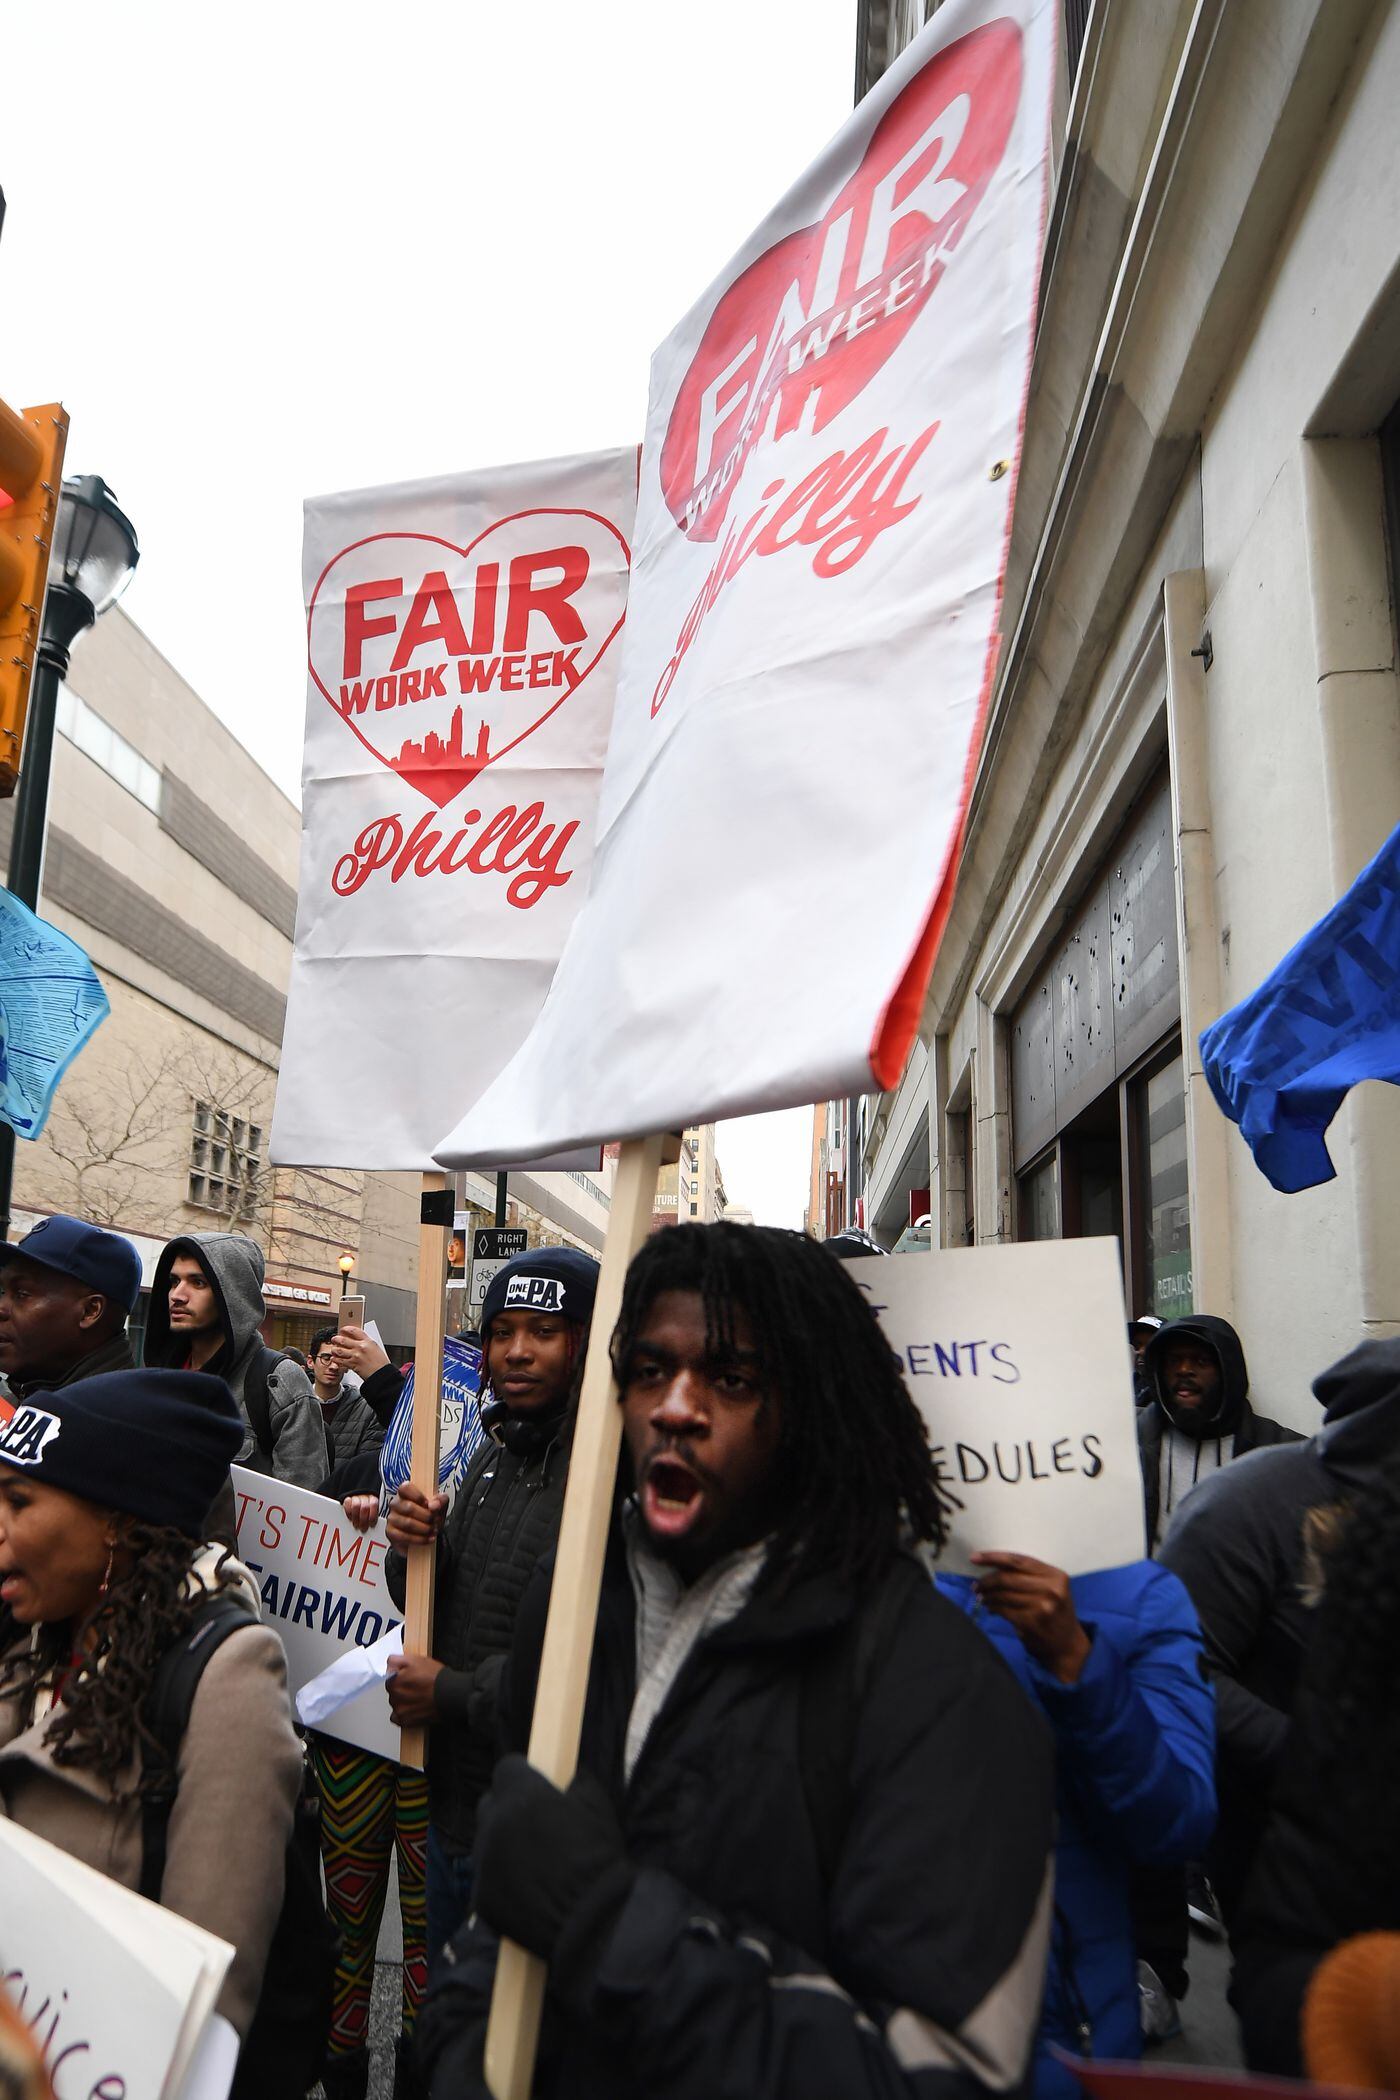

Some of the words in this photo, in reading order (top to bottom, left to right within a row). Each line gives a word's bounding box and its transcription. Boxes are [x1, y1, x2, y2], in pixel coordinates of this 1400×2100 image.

[692, 92, 970, 490] FAIR
[787, 216, 962, 375] WEEK
[342, 545, 590, 680] FAIR
[339, 659, 447, 716] WORK
[457, 646, 583, 695] WEEK
[331, 801, 581, 909] Philly
[497, 1233, 525, 1244] RIGHT
[498, 1247, 522, 1257] LANE
[508, 1282, 529, 1294] ONE
[525, 1279, 561, 1309] PA
[1157, 1273, 1186, 1300] RETAIL
[297, 1514, 387, 1587] TIME
